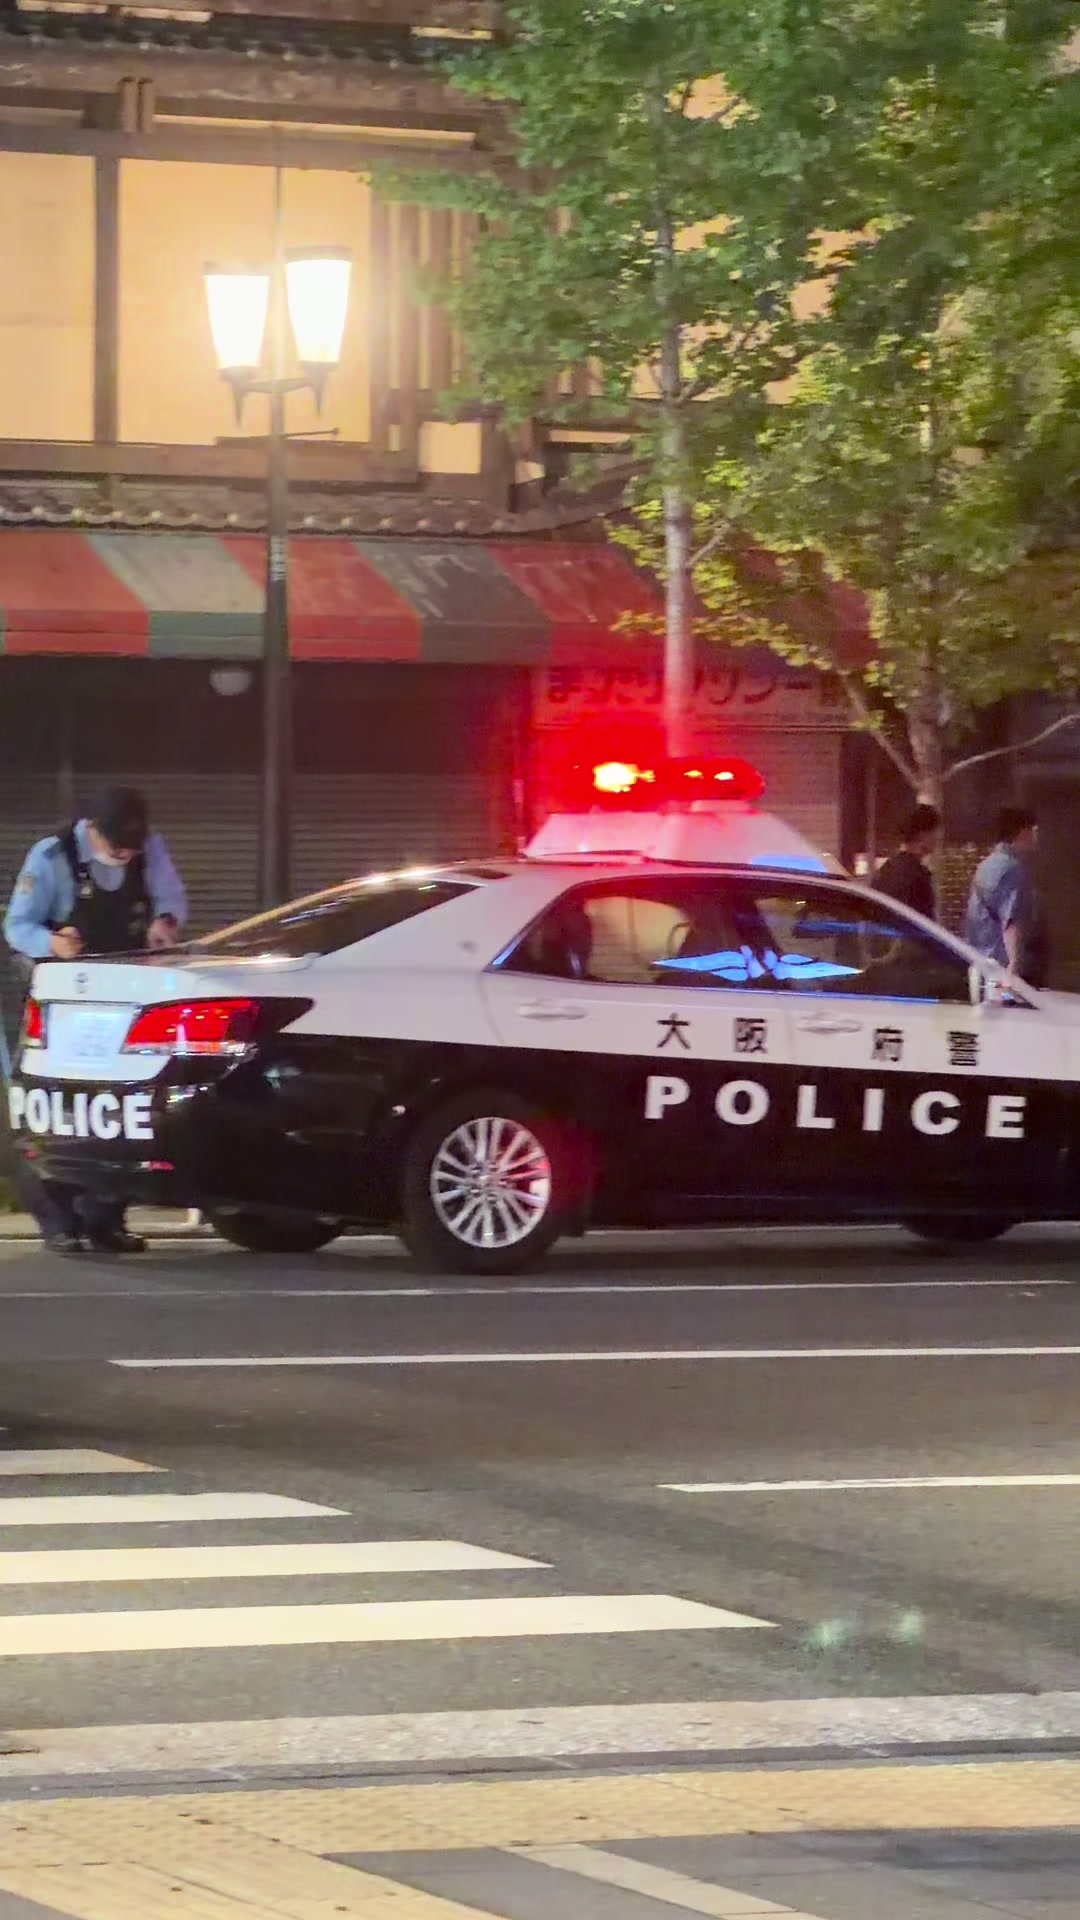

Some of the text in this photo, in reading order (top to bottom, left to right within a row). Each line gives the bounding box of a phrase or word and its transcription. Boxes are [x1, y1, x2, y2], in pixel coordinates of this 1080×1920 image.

[656, 1013, 981, 1067] 大阪府警
[8, 1086, 155, 1140] POLICE
[644, 1075, 1028, 1139] POLICE
